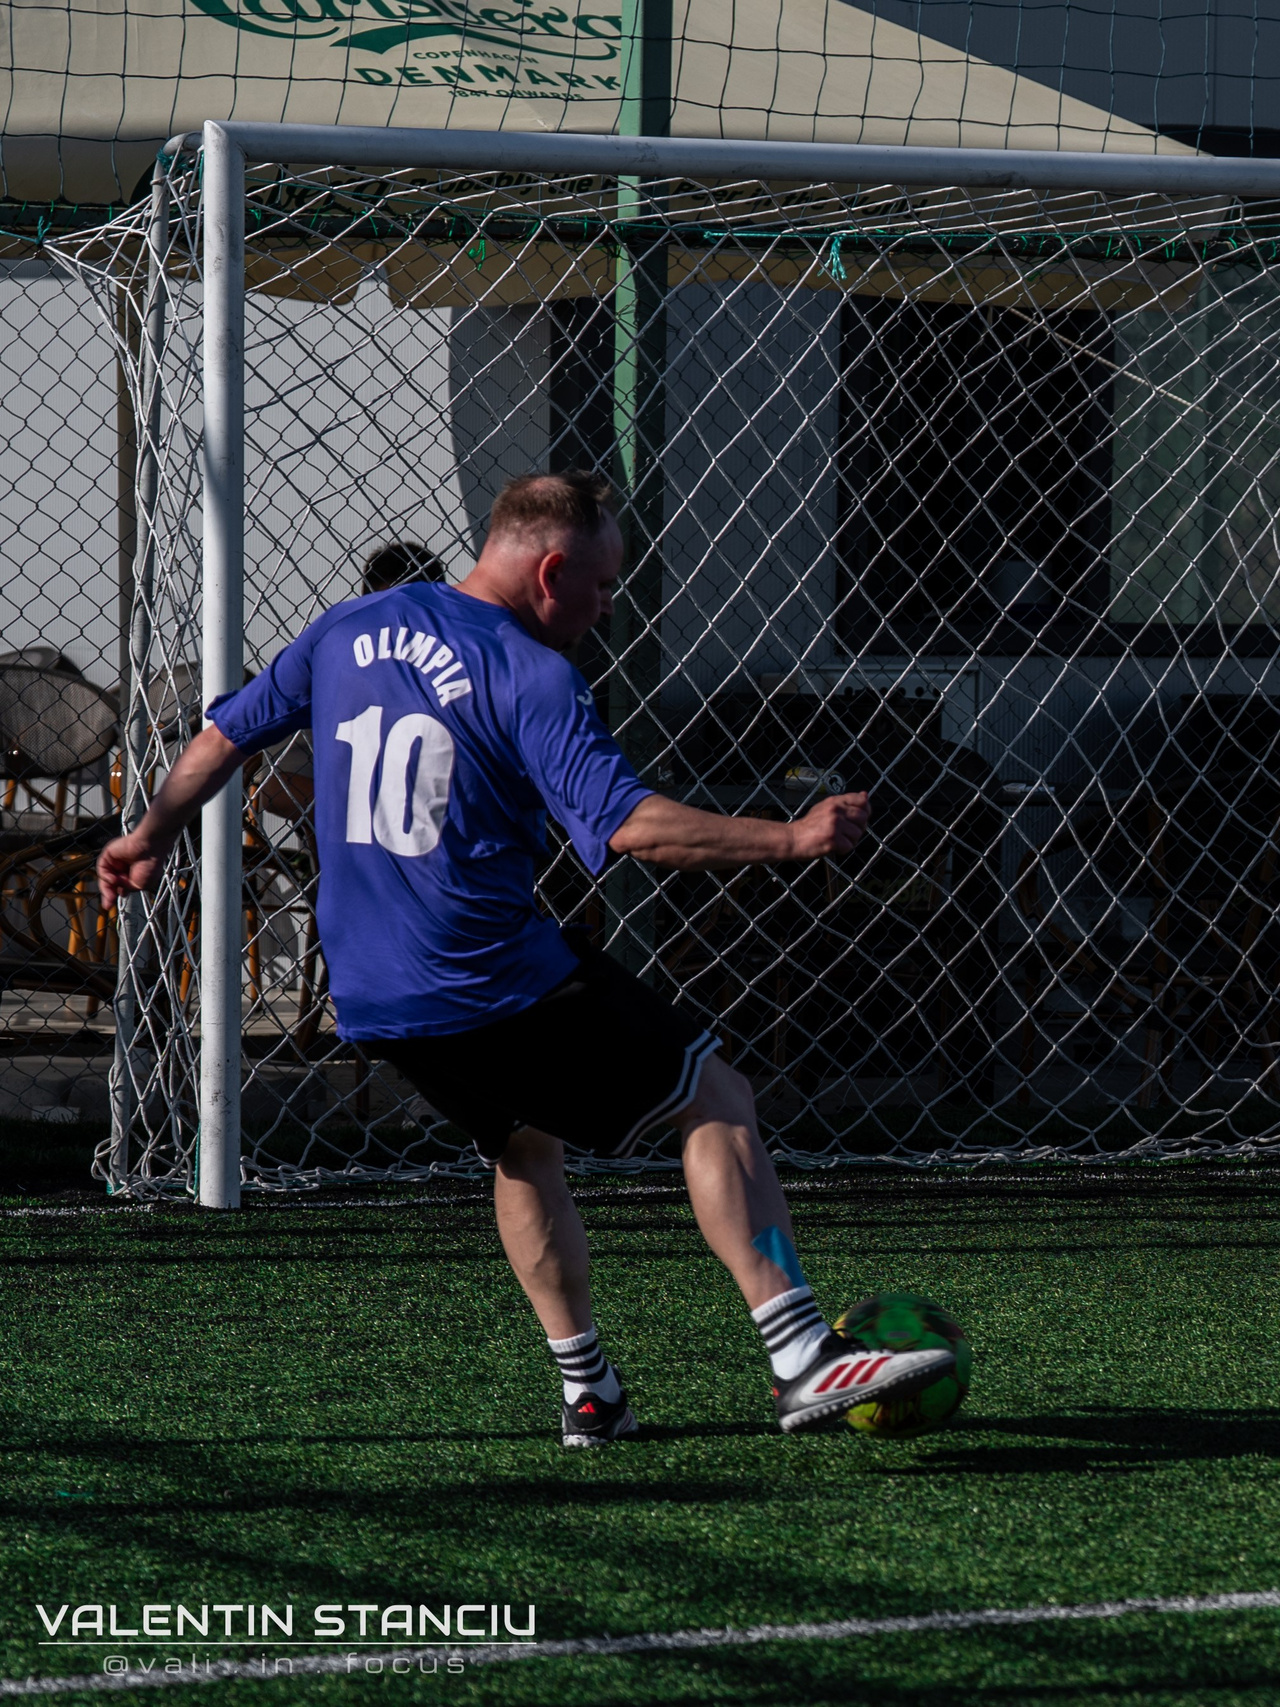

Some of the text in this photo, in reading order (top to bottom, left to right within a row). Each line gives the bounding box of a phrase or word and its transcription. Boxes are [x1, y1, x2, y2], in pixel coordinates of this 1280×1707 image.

[413, 49, 539, 64] COPENHAGEN
[353, 64, 621, 91] DENMARK
[402, 169, 541, 196] Probably
[353, 626, 472, 708] OLIMPIA
[335, 704, 454, 857] 10
